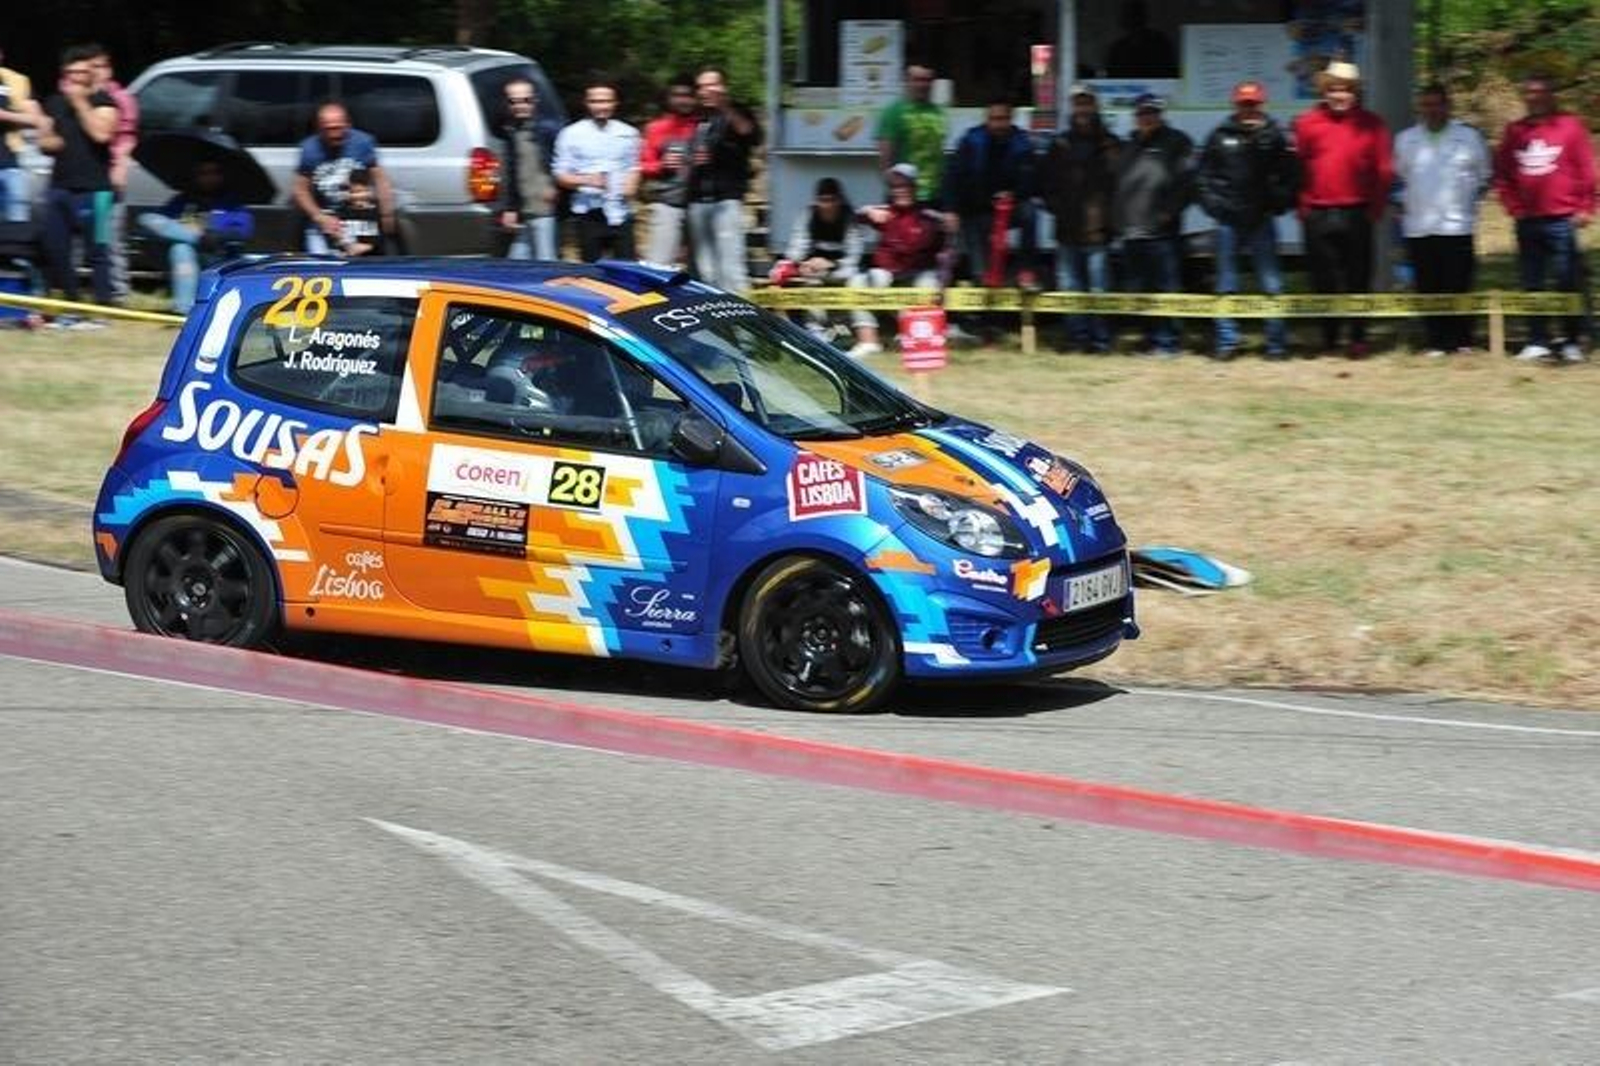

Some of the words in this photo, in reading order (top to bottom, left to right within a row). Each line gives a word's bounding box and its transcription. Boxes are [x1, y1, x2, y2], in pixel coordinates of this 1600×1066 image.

[263, 276, 332, 328] 28
[309, 327, 381, 350] Aragonés
[283, 350, 298, 369] J.
[300, 350, 377, 378] Rodríguez
[550, 466, 601, 504] 28
[800, 480, 857, 508] LISBOA
[308, 564, 385, 600] Lisboa
[624, 584, 697, 621] Sierra
